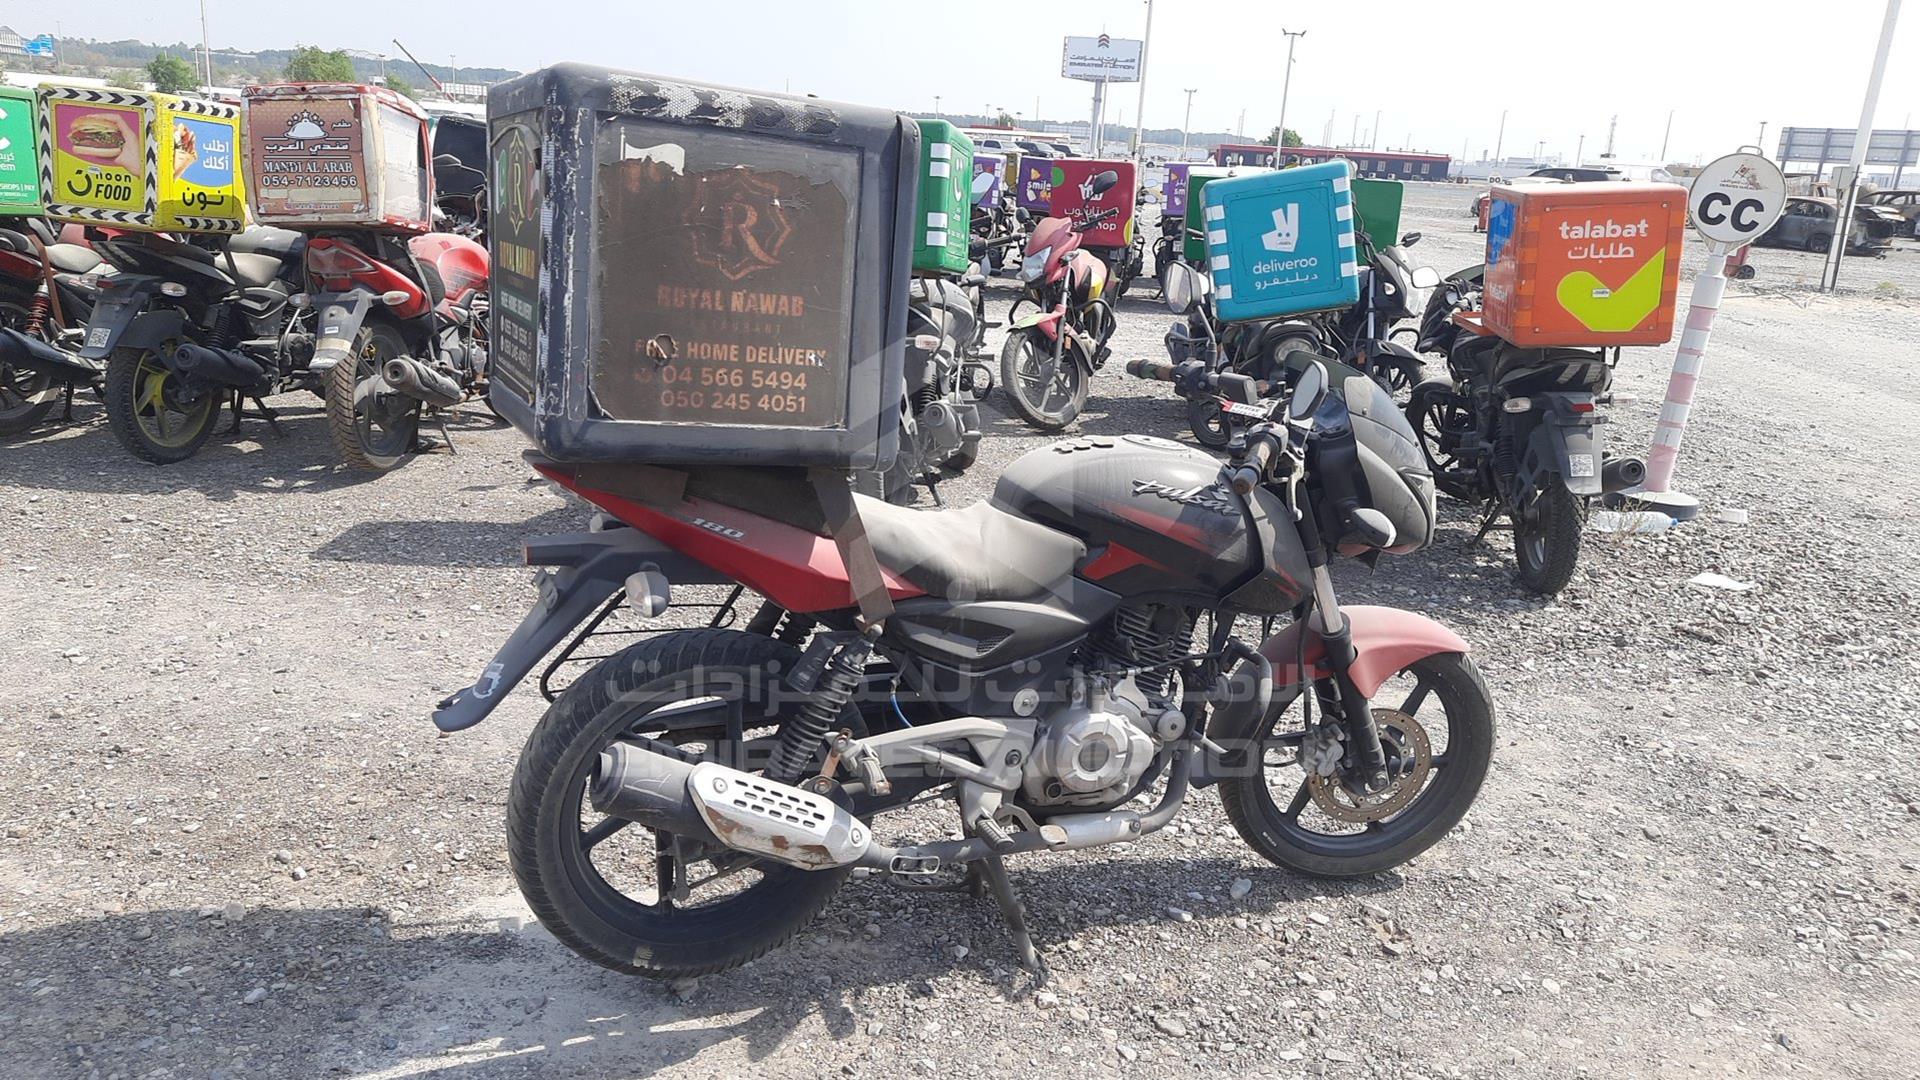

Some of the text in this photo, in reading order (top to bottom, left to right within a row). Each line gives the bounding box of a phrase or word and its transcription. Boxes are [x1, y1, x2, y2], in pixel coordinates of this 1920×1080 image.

[265, 140, 349, 156] مندي العرب
[263, 161, 353, 173] MANDI AL ARAB
[95, 172, 132, 183] noon
[262, 176, 357, 187] 054-7123456
[94, 183, 132, 201] FOOD
[183, 187, 225, 211] نون
[1698, 192, 1765, 233] CC
[1559, 218, 1649, 240] talabat
[1567, 242, 1636, 264] طلبات
[1253, 257, 1318, 274] deliveroo
[1255, 272, 1319, 291] ديليفرو
[657, 284, 806, 317] ROYAL NAWAB
[687, 342, 739, 362] HOME
[662, 365, 807, 390] 04 566 5494
[660, 390, 806, 413] 050 245 4051
